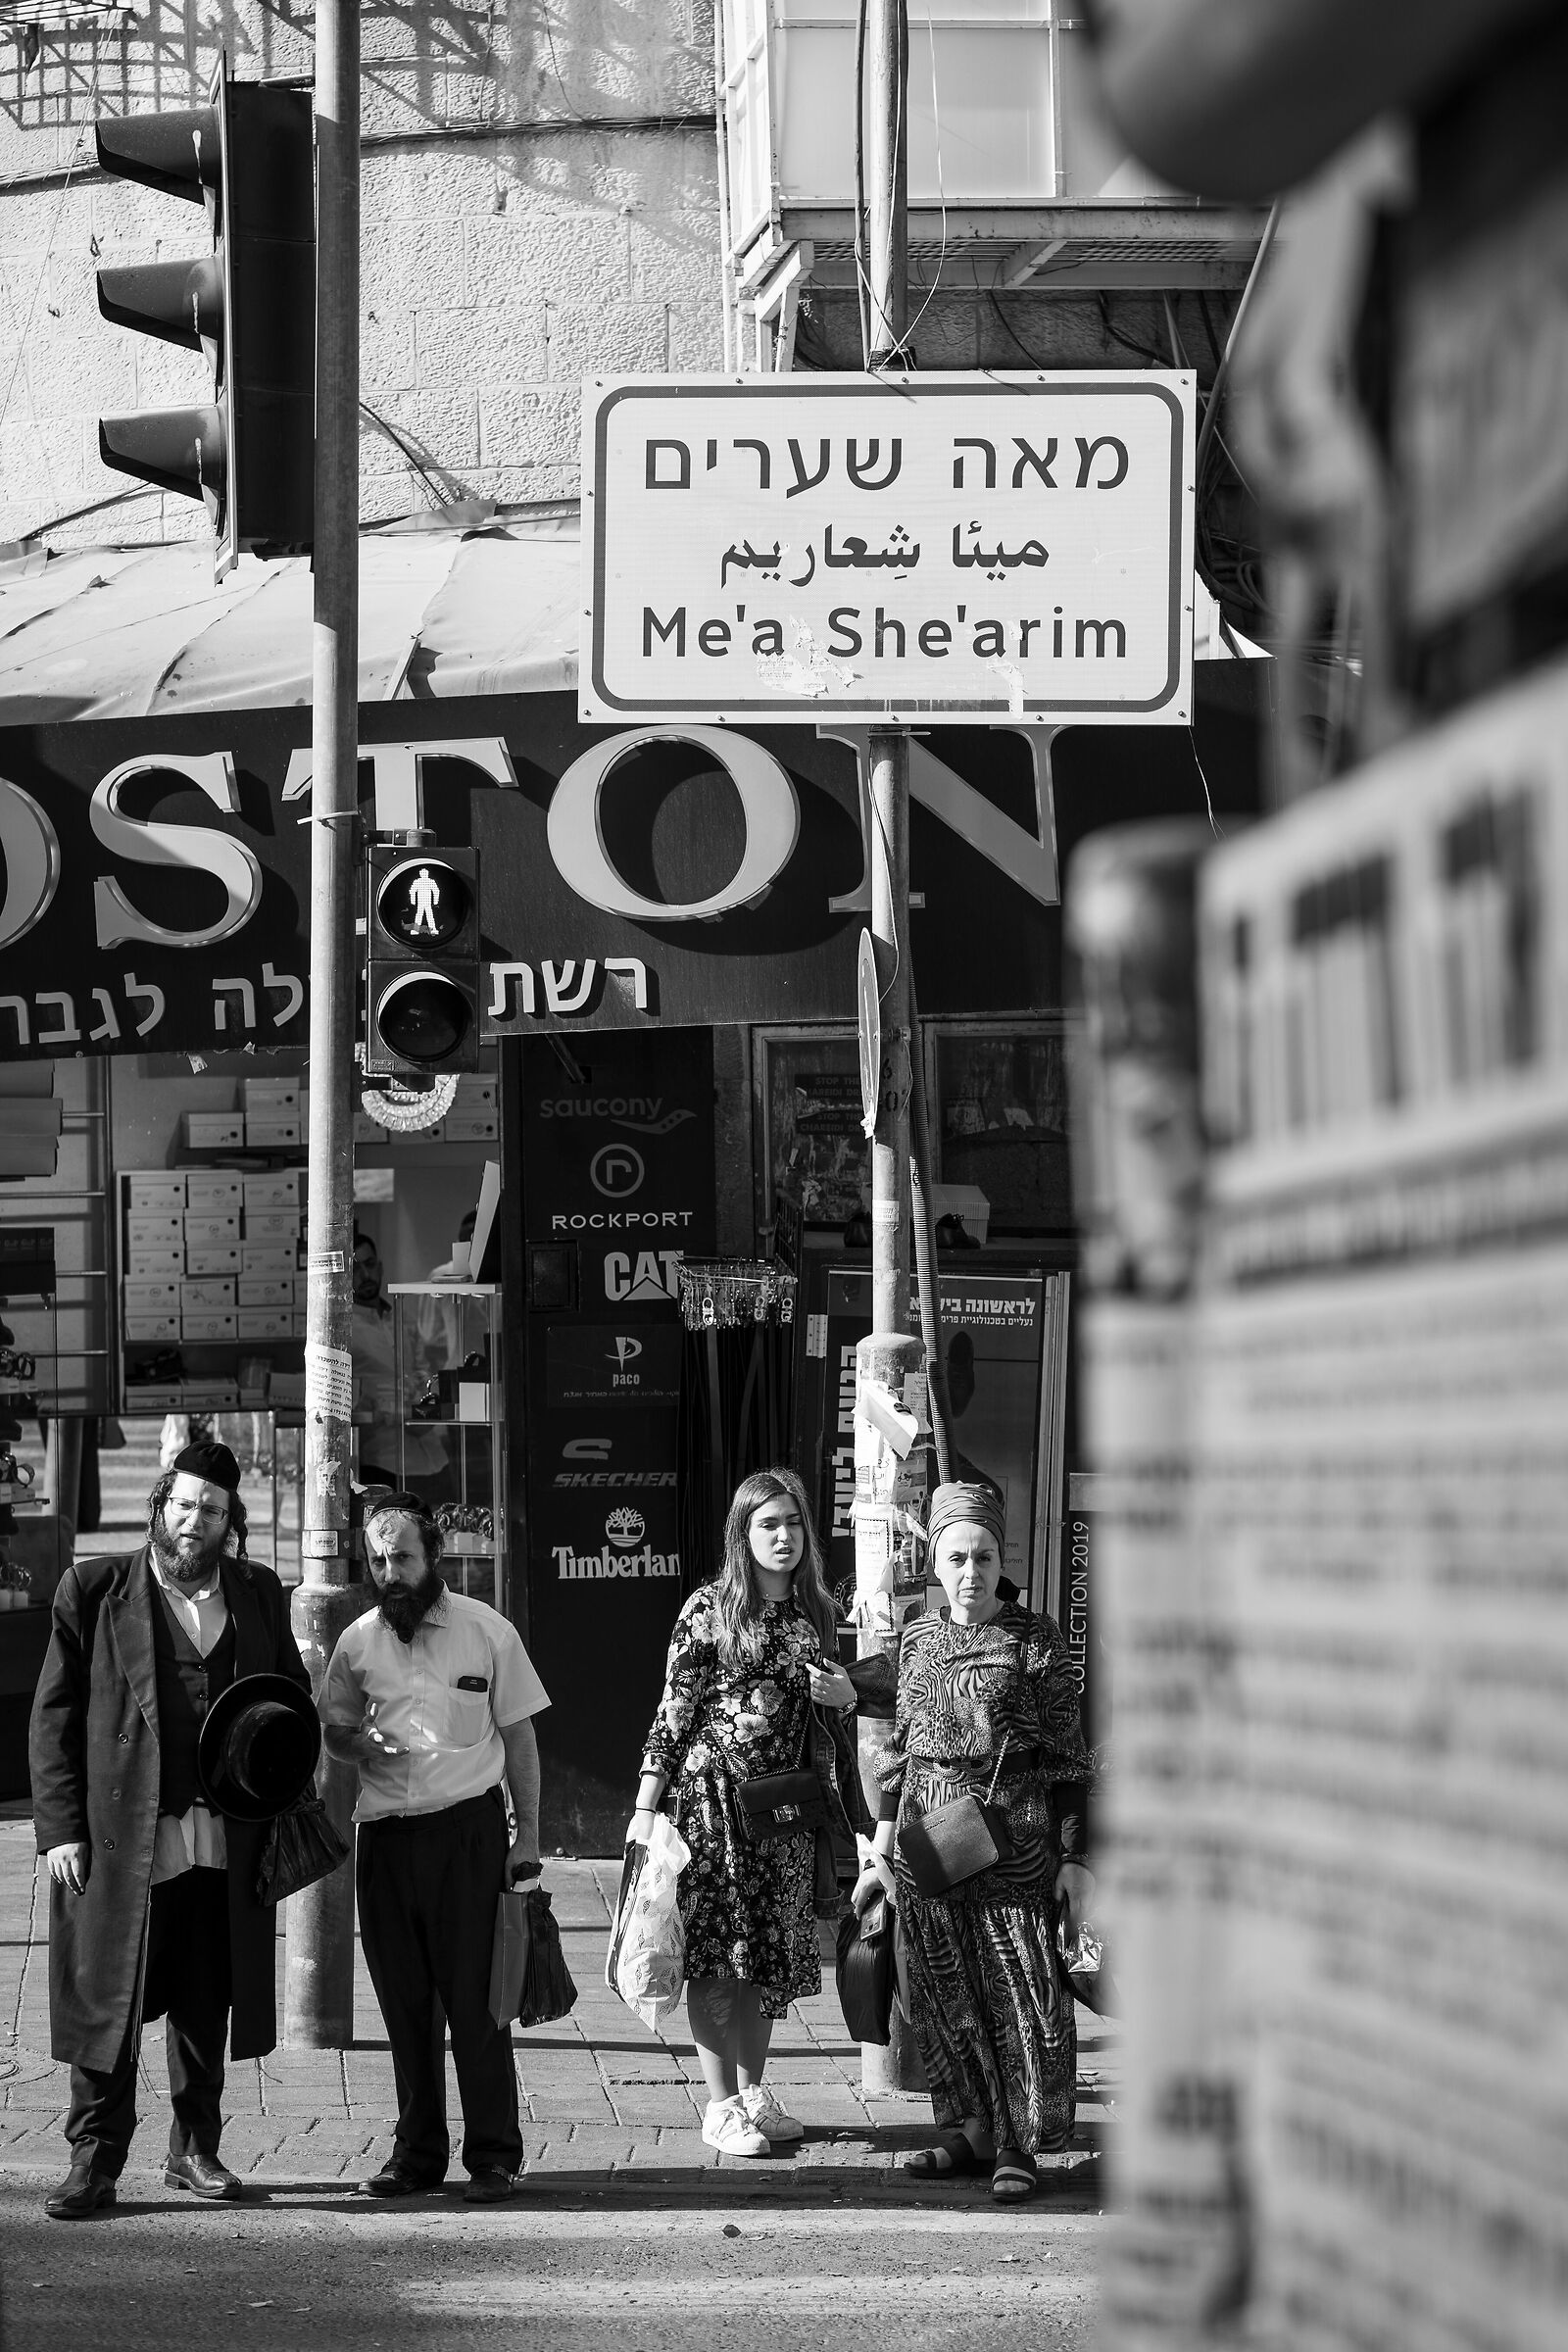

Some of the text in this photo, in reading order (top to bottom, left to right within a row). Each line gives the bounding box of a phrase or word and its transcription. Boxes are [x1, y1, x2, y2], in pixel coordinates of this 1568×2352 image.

[644, 433, 1130, 500] מאה שערים
[640, 604, 1128, 660] Me'a She'arim
[0, 723, 1062, 952] STON
[487, 956, 648, 1016] רשת
[539, 1096, 663, 1120] saucony
[552, 1211, 693, 1230] ROCKPORT
[604, 1250, 684, 1301] CAT
[965, 1298, 1036, 1315] לראשונה
[1007, 1317, 1033, 1327] נעליים
[612, 1374, 641, 1388] paco
[551, 1544, 681, 1580] Timberlan
[1071, 1520, 1090, 1568] 2019
